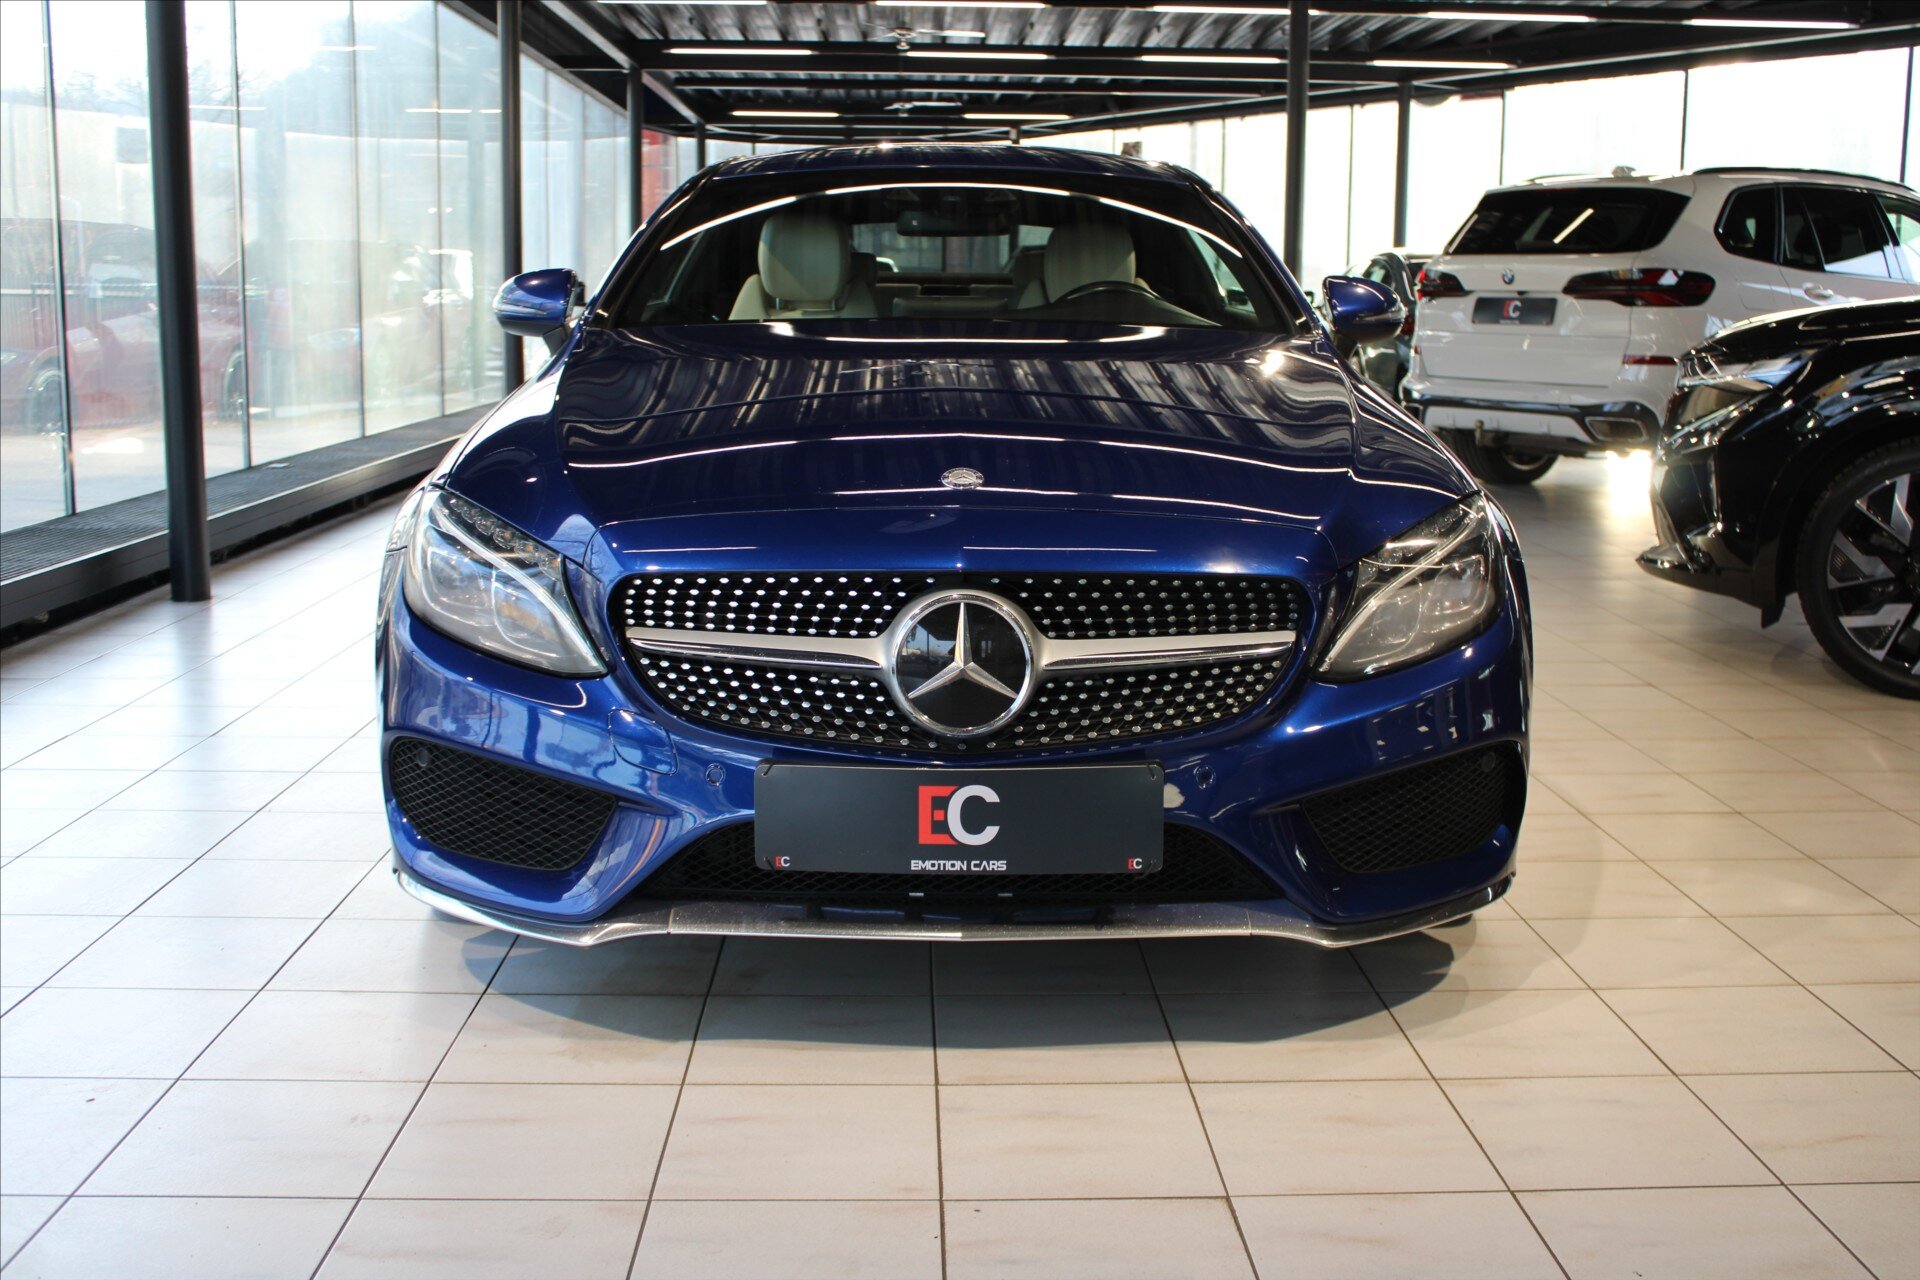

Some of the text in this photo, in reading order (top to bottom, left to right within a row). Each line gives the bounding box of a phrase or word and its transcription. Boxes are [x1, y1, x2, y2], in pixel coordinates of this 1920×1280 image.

[918, 784, 1000, 846] EC
[775, 856, 791, 867] EC
[910, 860, 1007, 871] EMOTION CARS
[1128, 858, 1143, 869] EC
